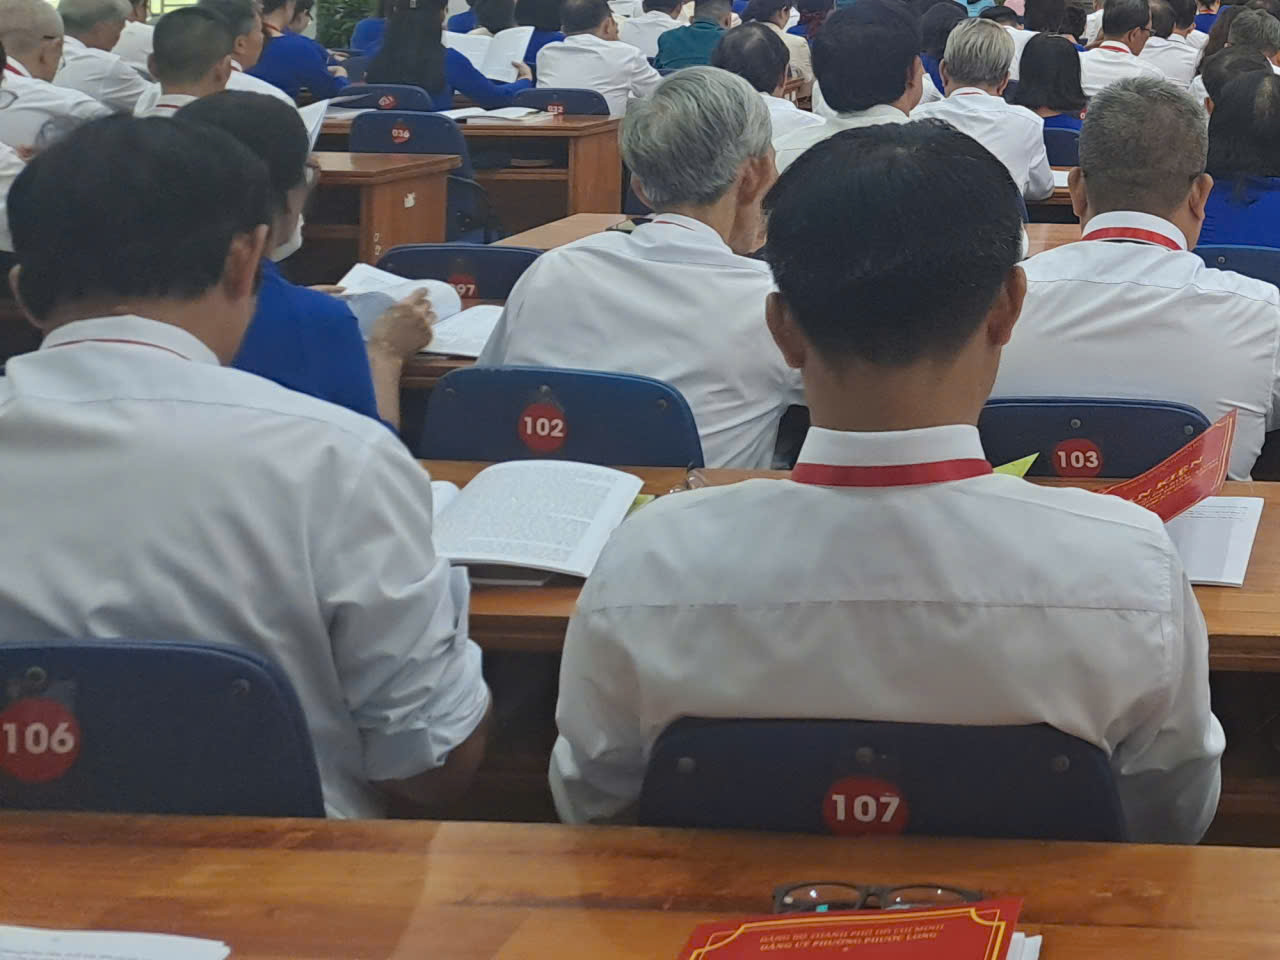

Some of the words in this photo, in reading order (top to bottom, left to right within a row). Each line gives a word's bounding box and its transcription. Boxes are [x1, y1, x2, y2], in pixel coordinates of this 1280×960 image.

[391, 128, 410, 139] 036
[523, 416, 564, 439] 102
[1057, 450, 1099, 468] 103
[1, 721, 76, 755] 106
[831, 793, 902, 824] 107
